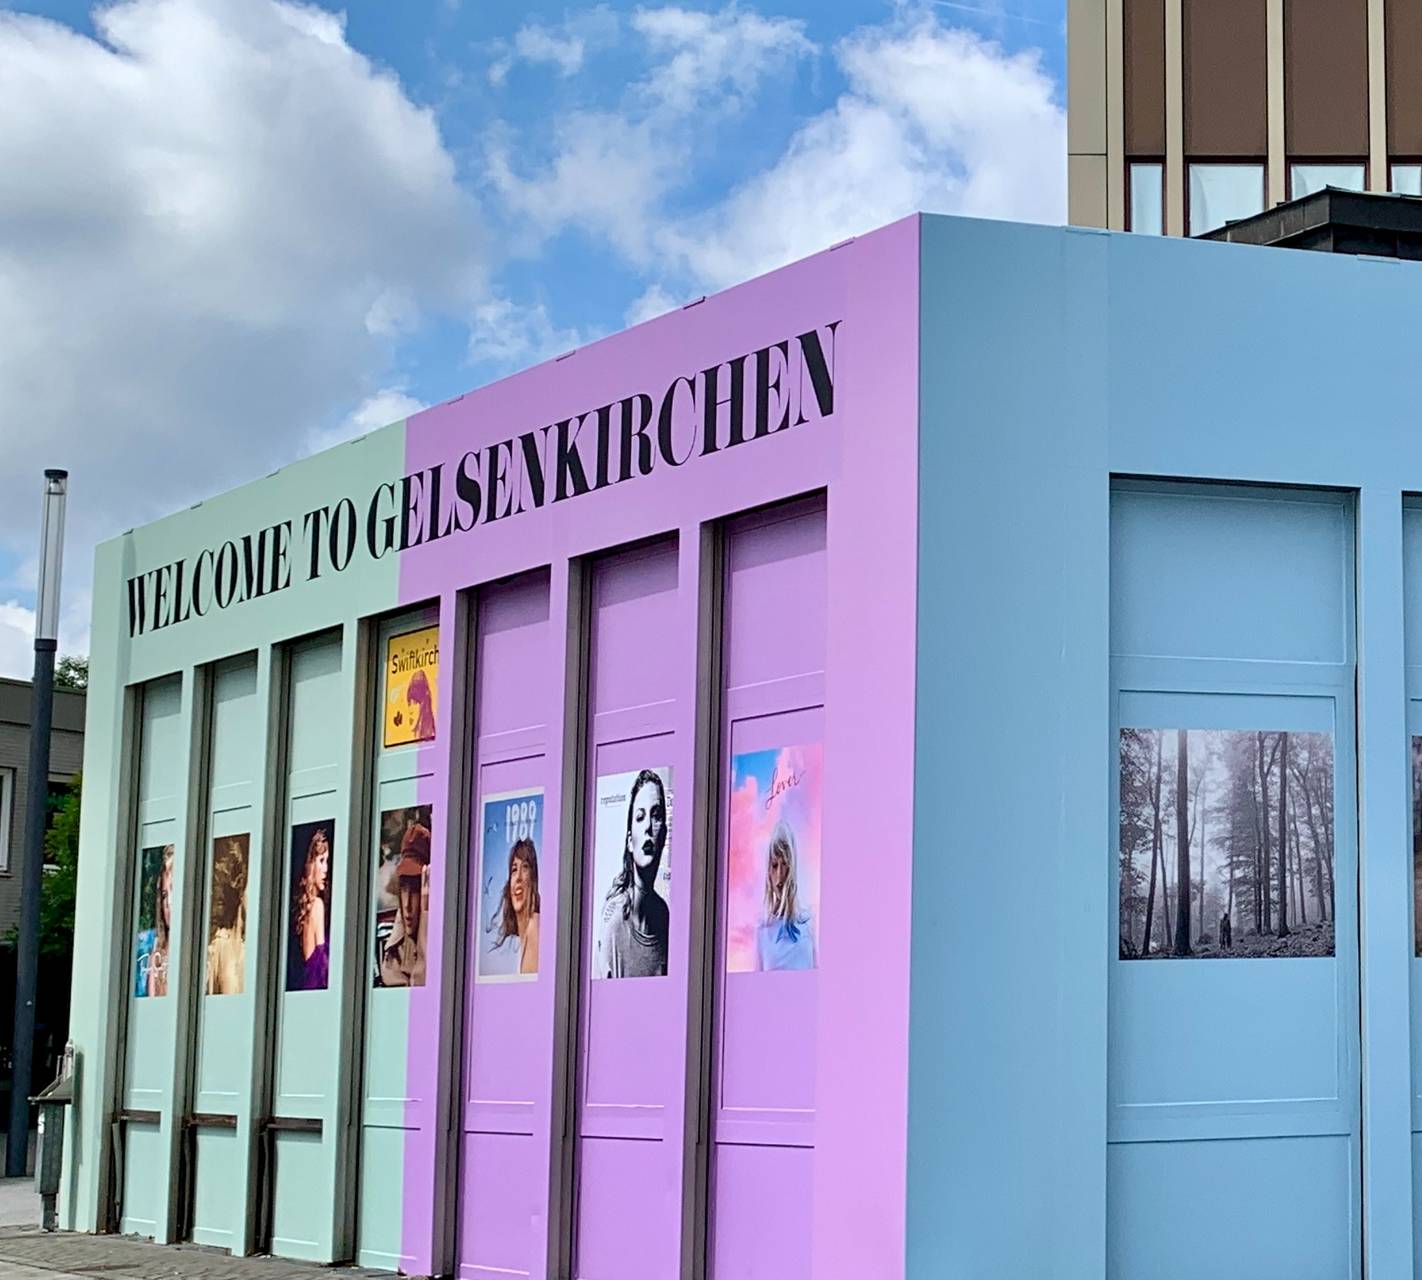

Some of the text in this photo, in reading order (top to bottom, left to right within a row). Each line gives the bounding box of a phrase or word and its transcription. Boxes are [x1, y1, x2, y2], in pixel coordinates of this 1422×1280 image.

[127, 320, 843, 638] WELCOME TO GELSENKIRCHEN
